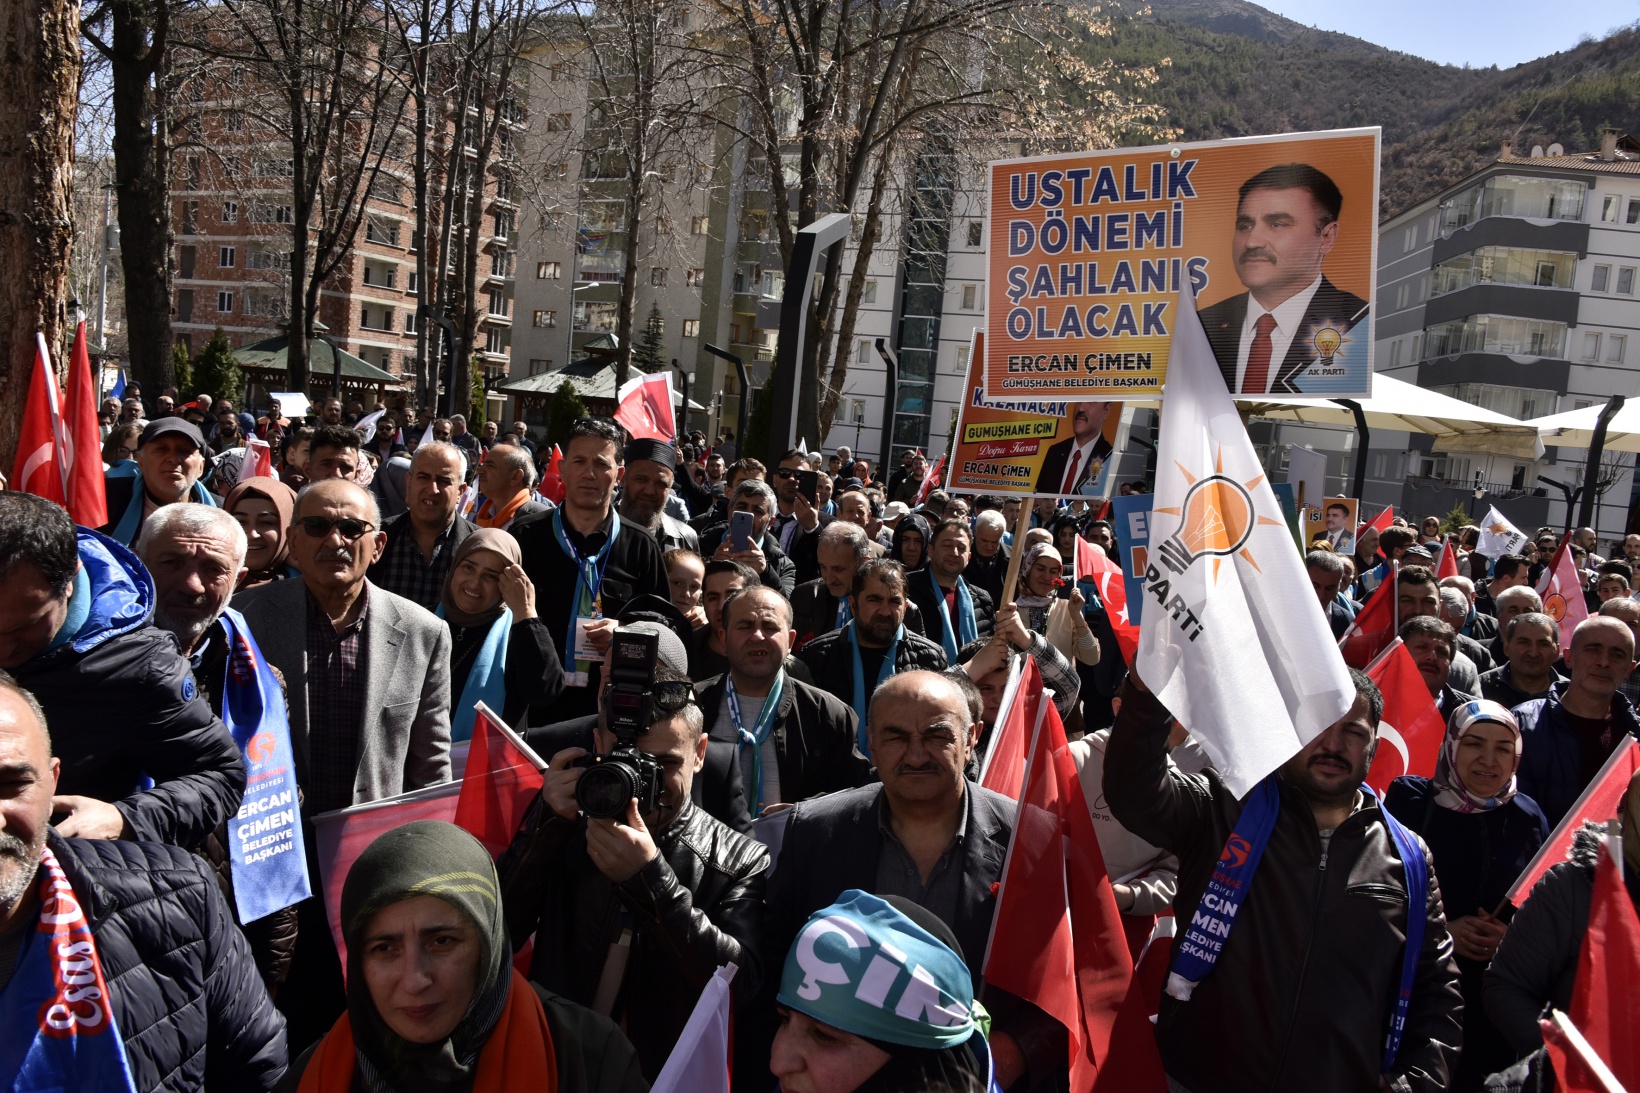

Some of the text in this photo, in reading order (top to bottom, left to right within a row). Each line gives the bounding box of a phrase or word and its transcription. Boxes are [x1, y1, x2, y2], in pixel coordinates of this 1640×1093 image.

[1010, 159, 1199, 210] USTALIK
[1008, 200, 1184, 257] DÖNEMİ
[1005, 255, 1210, 306] ŞAHLANIŞ
[1005, 301, 1170, 341] OLACAK
[1008, 353, 1079, 373] ERCAN
[1308, 368, 1320, 376] AK
[1002, 376, 1158, 390] GÜMÜŞHANE BELEDİYE BAŞKANI
[968, 422, 1053, 439] GÜMÜŞHANE İÇİN
[978, 441, 1038, 457] Doğru Karar
[963, 461, 999, 475] ERCAN
[236, 789, 292, 821] ERCAN
[242, 828, 293, 854] BELEDİYE
[244, 841, 293, 865] BAŞKANI
